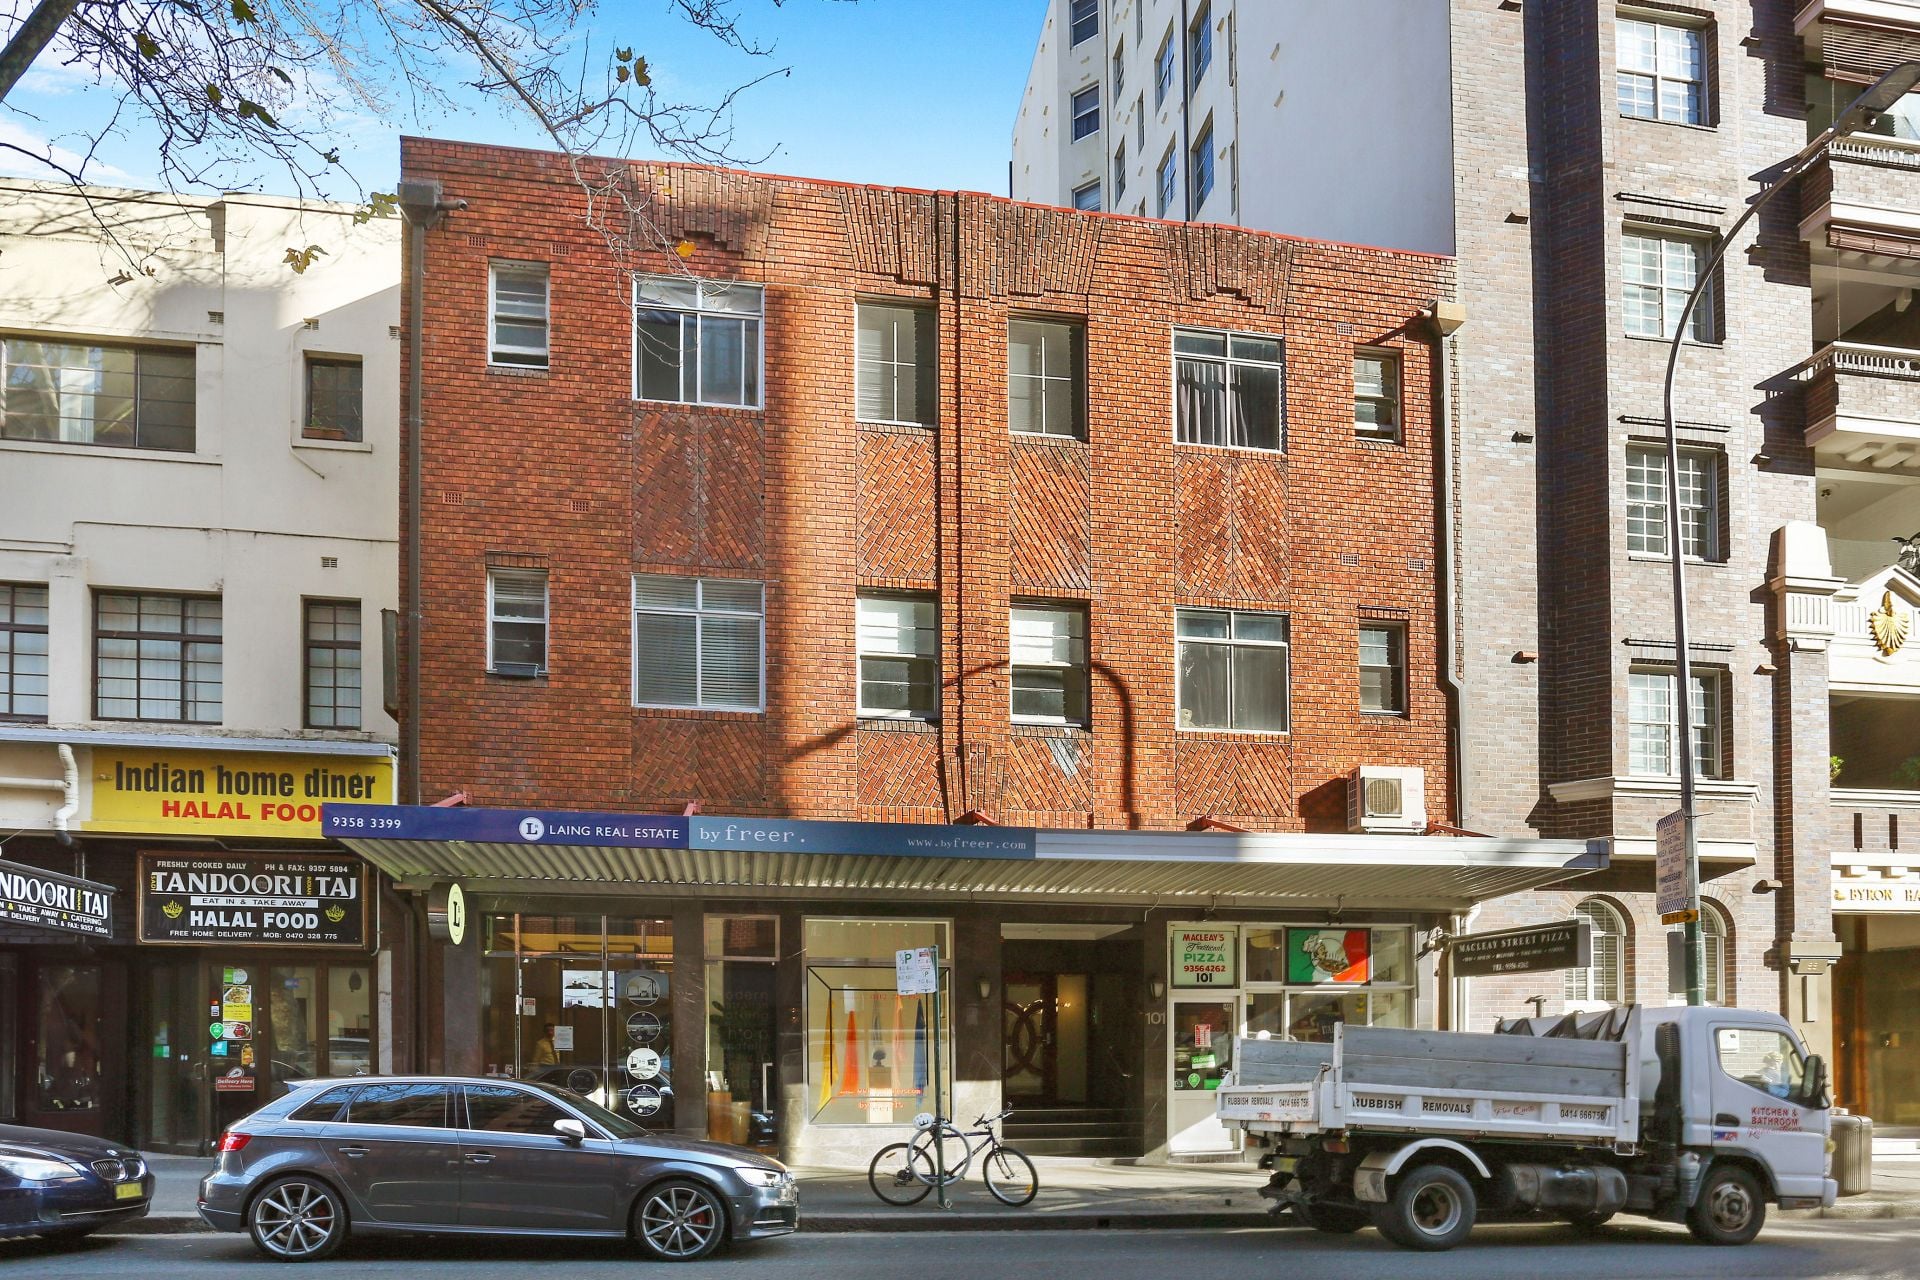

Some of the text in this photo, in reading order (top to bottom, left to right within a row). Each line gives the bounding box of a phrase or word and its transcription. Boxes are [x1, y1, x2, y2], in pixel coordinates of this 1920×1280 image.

[115, 761, 376, 799] Indian home diner
[161, 800, 251, 820] HALAL
[332, 816, 401, 829] 9358 3399
[549, 825, 679, 839] LAING REAL ESTATE
[906, 837, 1026, 850] www.byfreer.com
[157, 860, 247, 870] FRESHLY COOKED DAILY
[264, 863, 276, 871] PH
[287, 864, 305, 872] FAX:
[151, 871, 357, 899] TANDOORI TAJ
[1849, 888, 1893, 901] BYRON
[82, 889, 108, 919] TAJ
[11, 912, 41, 923] DELIVERY
[47, 918, 58, 926] TEL
[67, 921, 79, 929] FAX:
[18, 904, 37, 914] TAKE
[40, 908, 59, 918] AWAY
[62, 912, 68, 920] &
[71, 914, 102, 926] CATERING
[190, 910, 319, 929] HALAL FOOD
[1182, 933, 1225, 942] MACLEAY'S
[1459, 931, 1571, 953] MACLEAY STREET PIZZA
[905, 953, 912, 965] P
[1183, 953, 1225, 963] PIZZA
[1196, 972, 1213, 983] 101
[1144, 1012, 1166, 1025] 101
[1227, 1097, 1274, 1106] RUBBISH REMOVALS
[1352, 1097, 1471, 1114] RUBBISH REMOVALS
[1560, 1109, 1577, 1118] 0414
[1751, 1107, 1798, 1117] KITCHEN &
[1751, 1116, 1798, 1127] BATHROOM
